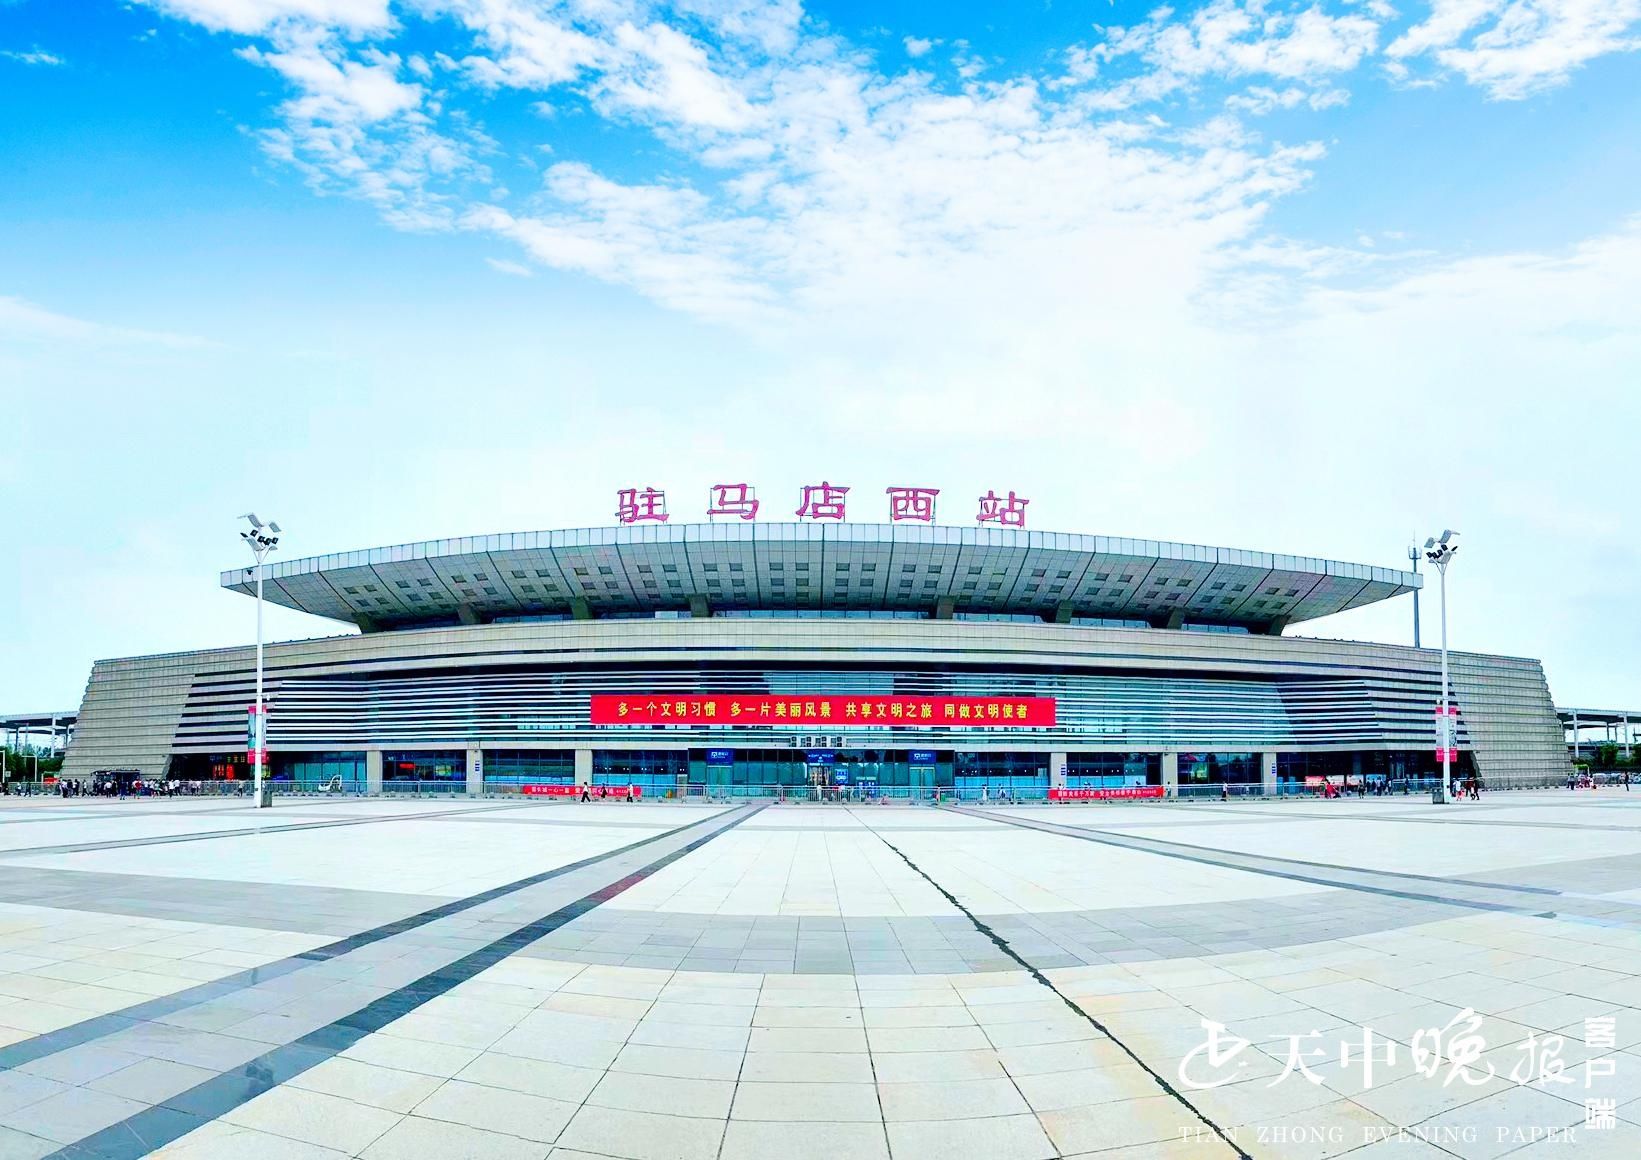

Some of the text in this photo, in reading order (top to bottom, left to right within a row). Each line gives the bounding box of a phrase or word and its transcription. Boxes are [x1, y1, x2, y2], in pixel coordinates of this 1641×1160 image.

[615, 482, 1030, 527] 驻马店西站
[617, 701, 1028, 720] 多一个文明习惯 多一片美丽风景 共享文明之旅 同做文明使者
